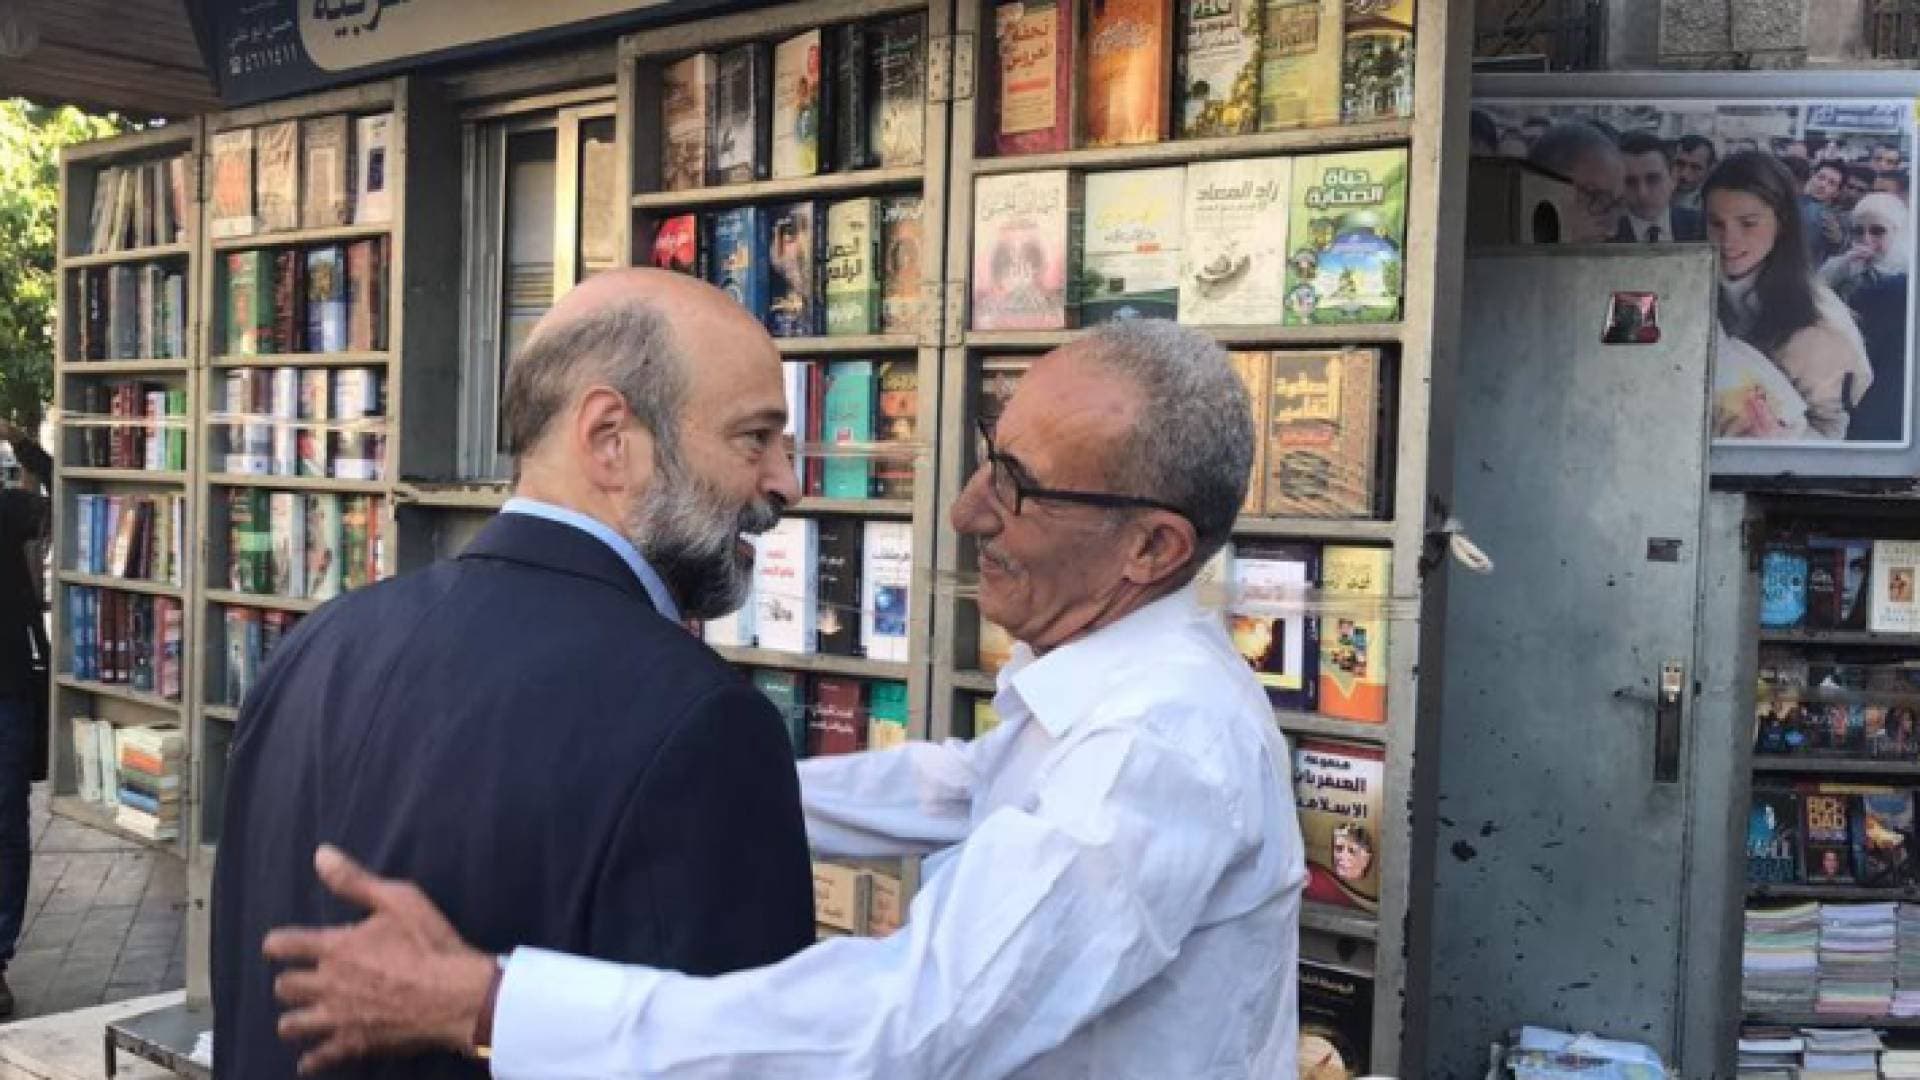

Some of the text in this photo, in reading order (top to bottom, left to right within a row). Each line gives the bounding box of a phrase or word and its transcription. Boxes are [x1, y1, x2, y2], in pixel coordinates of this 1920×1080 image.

[1324, 168, 1368, 186] حياة
[1195, 178, 1280, 202] زاد المعاد
[1306, 184, 1384, 208] الصحابة
